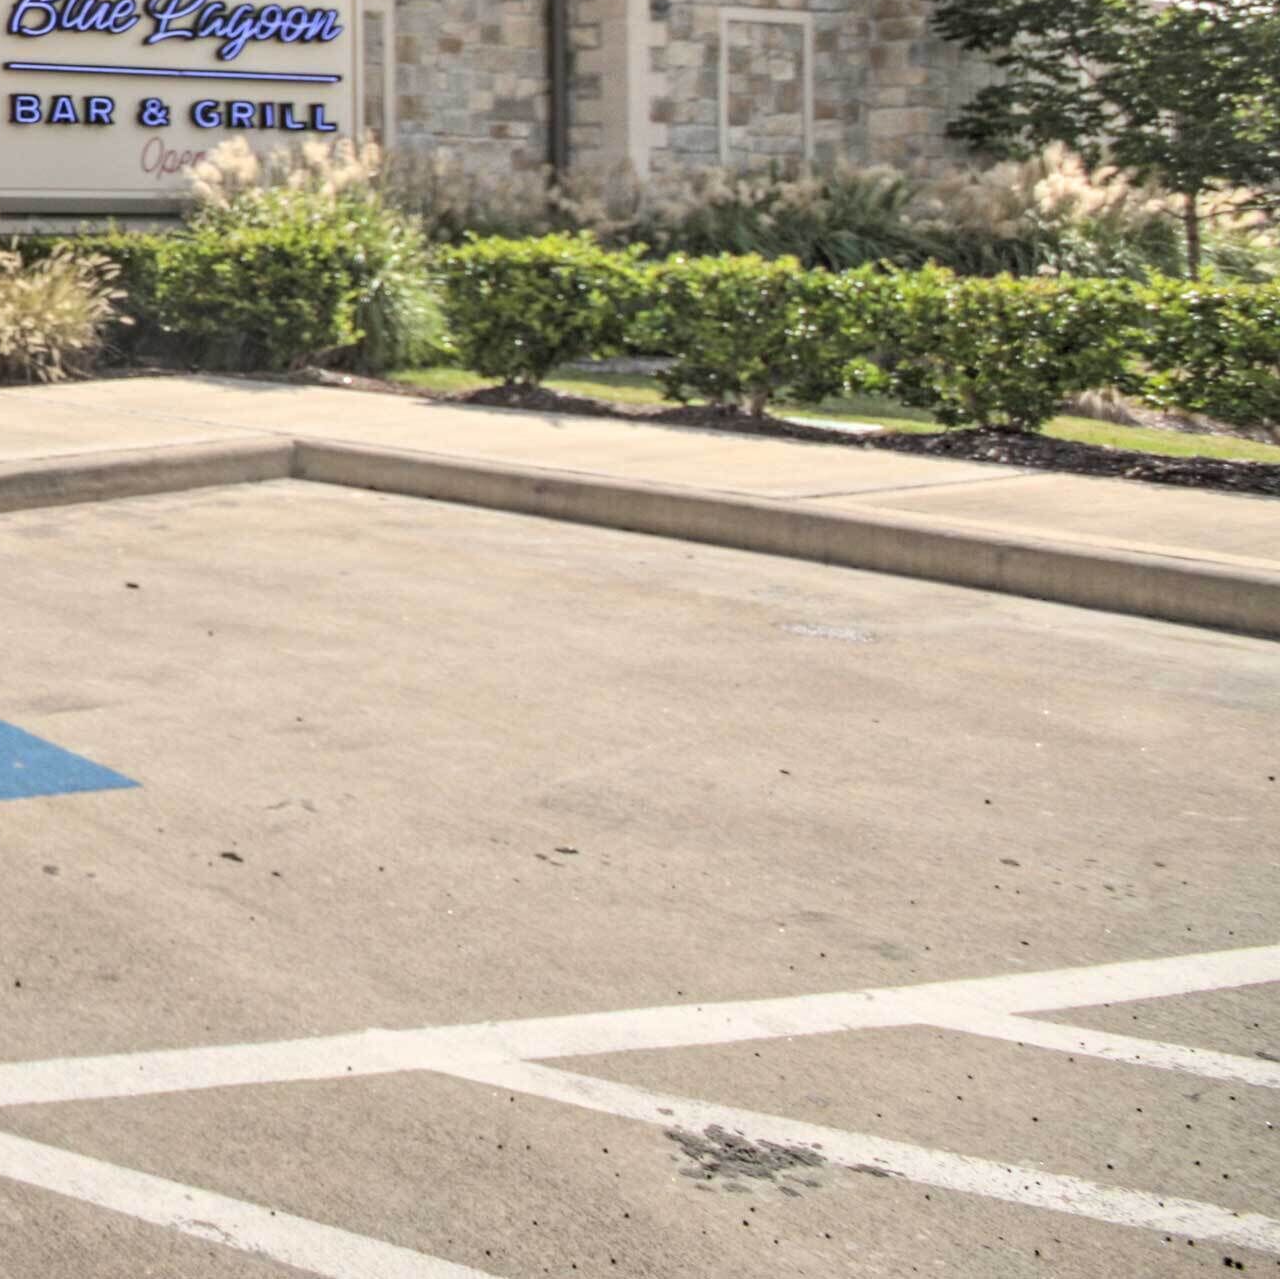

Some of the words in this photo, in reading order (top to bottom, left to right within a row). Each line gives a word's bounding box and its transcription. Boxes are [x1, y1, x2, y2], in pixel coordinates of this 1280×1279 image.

[10, 93, 115, 125] BAR
[139, 97, 169, 127] &
[191, 99, 337, 132] GRILL
